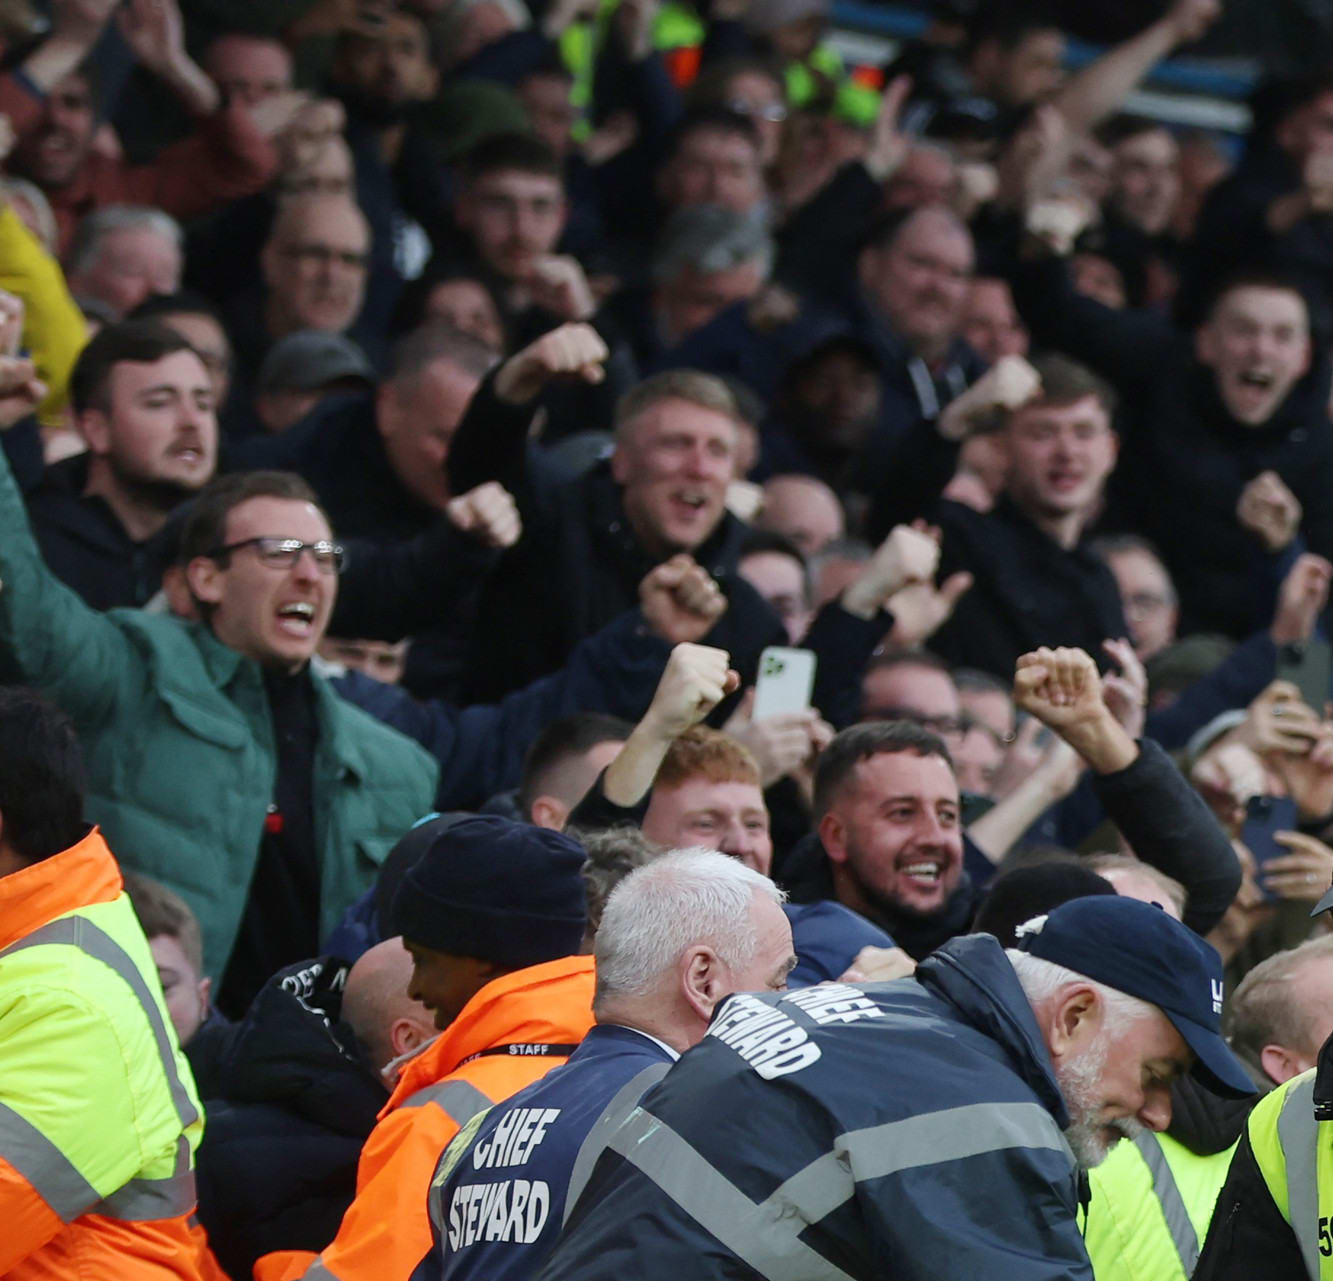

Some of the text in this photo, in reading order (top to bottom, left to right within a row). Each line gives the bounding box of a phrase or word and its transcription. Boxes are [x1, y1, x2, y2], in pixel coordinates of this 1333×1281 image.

[508, 1043, 549, 1056] STAFF
[704, 993, 823, 1081] STEWARD
[473, 1108, 562, 1171] CHIEF
[449, 1179, 550, 1253] STEWARD
